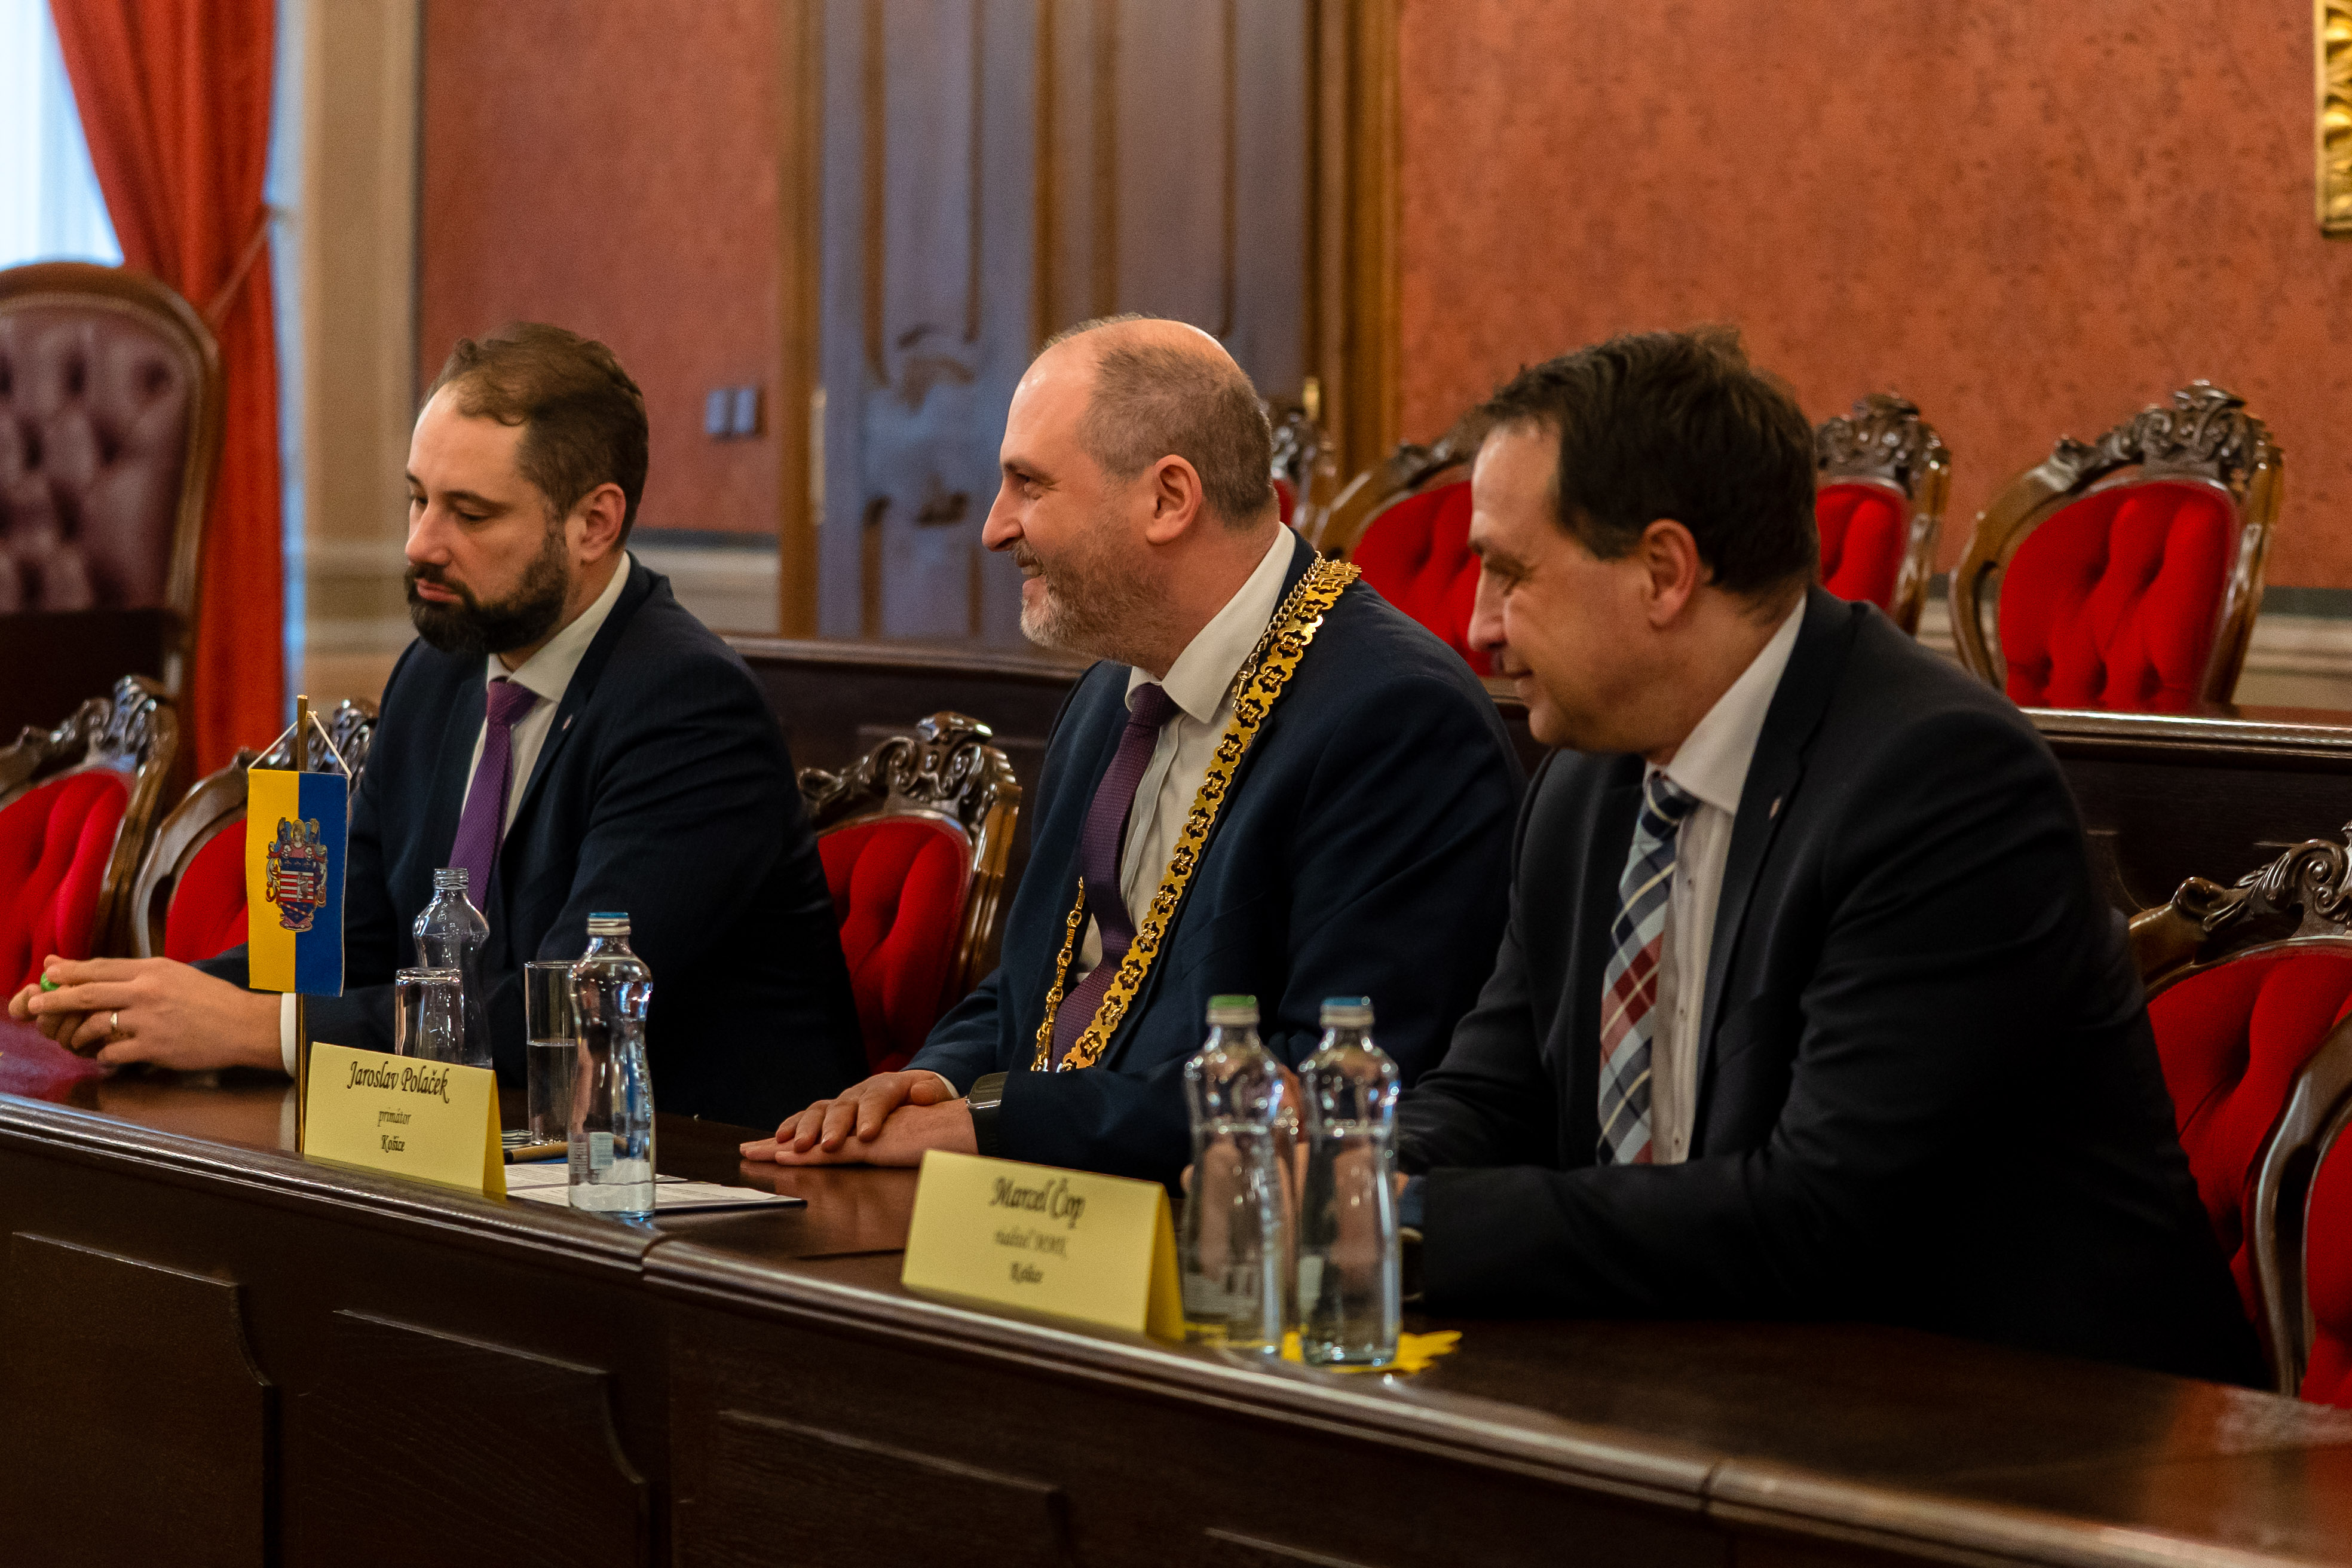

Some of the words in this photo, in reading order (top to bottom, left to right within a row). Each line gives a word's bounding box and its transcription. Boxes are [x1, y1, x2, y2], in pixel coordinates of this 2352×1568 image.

[347, 1061, 399, 1091] Jaroslav
[377, 1107, 412, 1127] primátor
[381, 1135, 406, 1153] Košice
